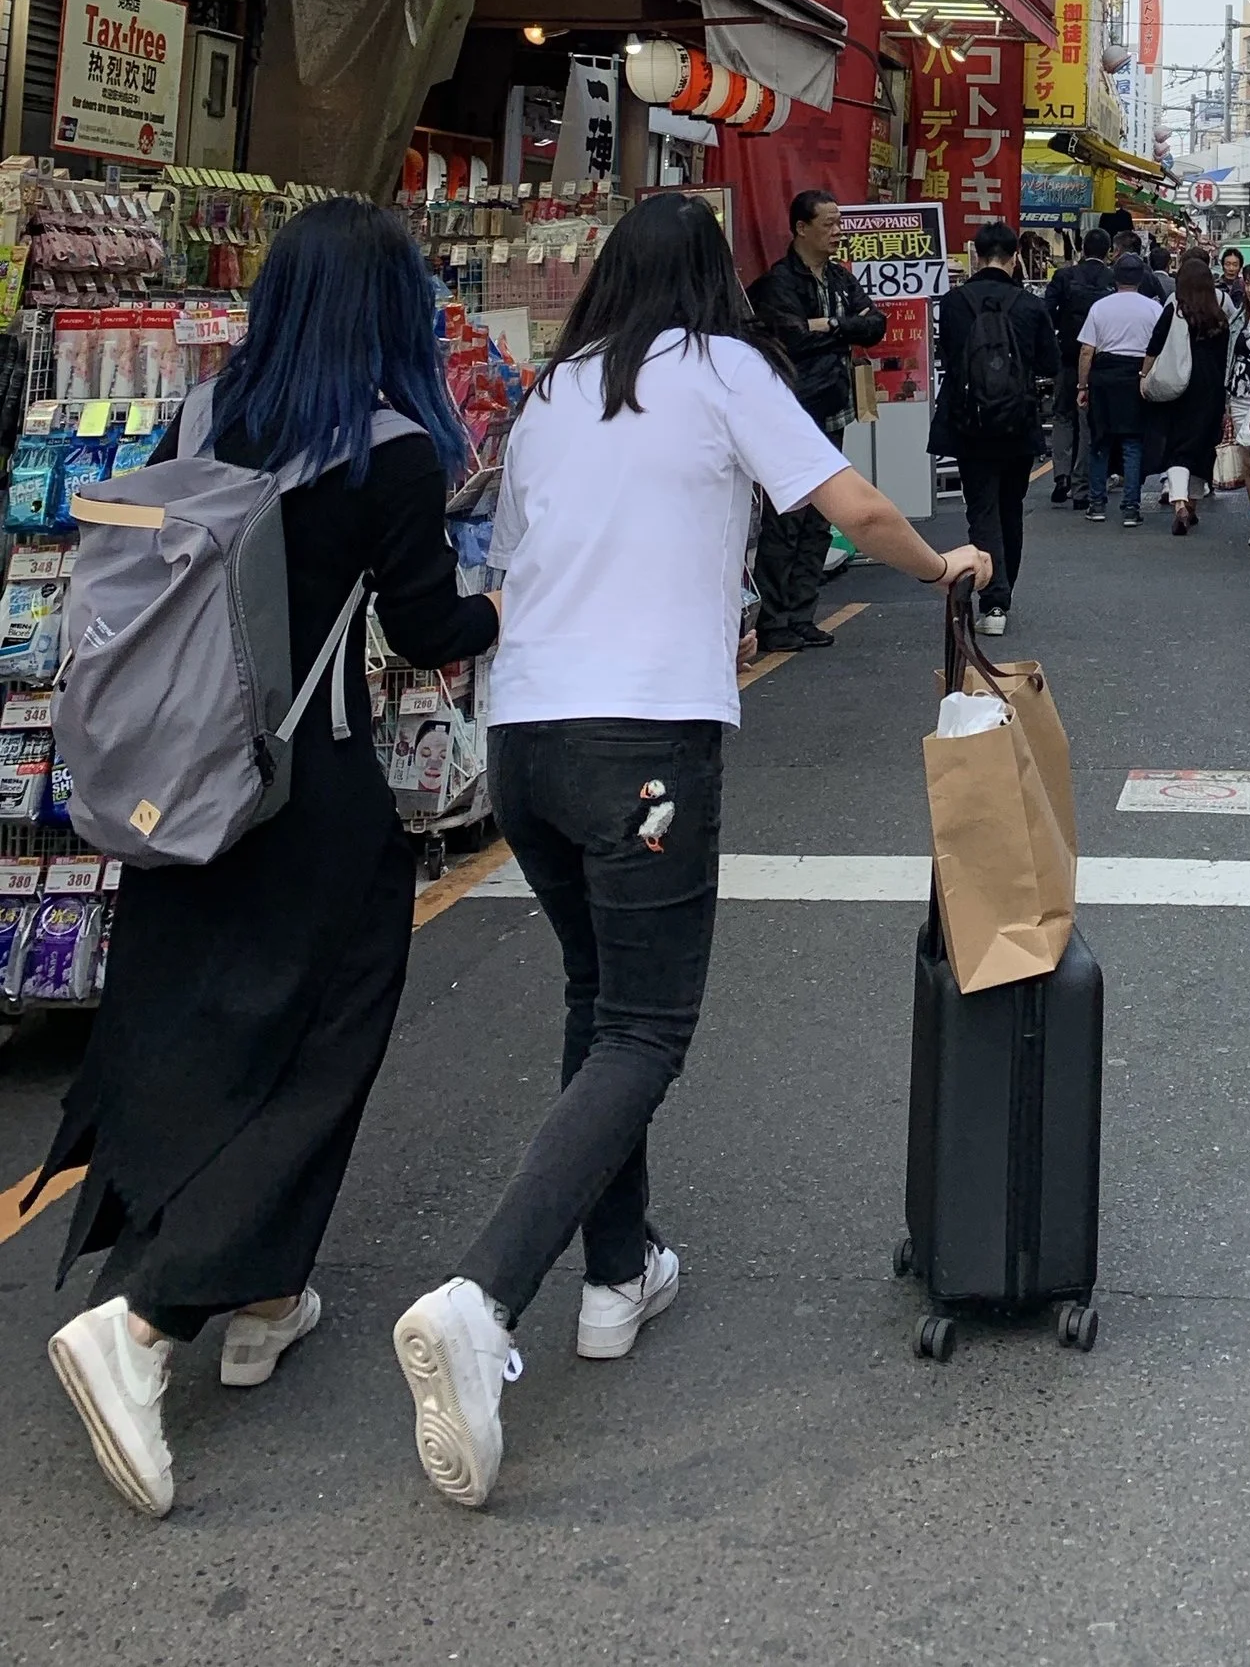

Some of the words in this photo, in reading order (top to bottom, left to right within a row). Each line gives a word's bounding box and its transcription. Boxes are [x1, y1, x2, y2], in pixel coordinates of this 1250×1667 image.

[85, 3, 167, 62] Tax-free
[1062, 3, 1083, 64] 御徒町
[87, 49, 157, 95] 热烈欢迎
[1042, 103, 1075, 119] 入口
[920, 45, 958, 200] バーディ館
[961, 46, 1010, 239] コトブキ
[885, 215, 920, 229] PARIS
[1019, 212, 1061, 222] HERS
[857, 260, 946, 297] 4857
[9, 477, 45, 493] FACE
[64, 471, 100, 486] FACE
[30, 561, 53, 574] 348
[23, 709, 47, 722] 348
[8, 875, 32, 888] 380
[67, 873, 91, 887] 380
